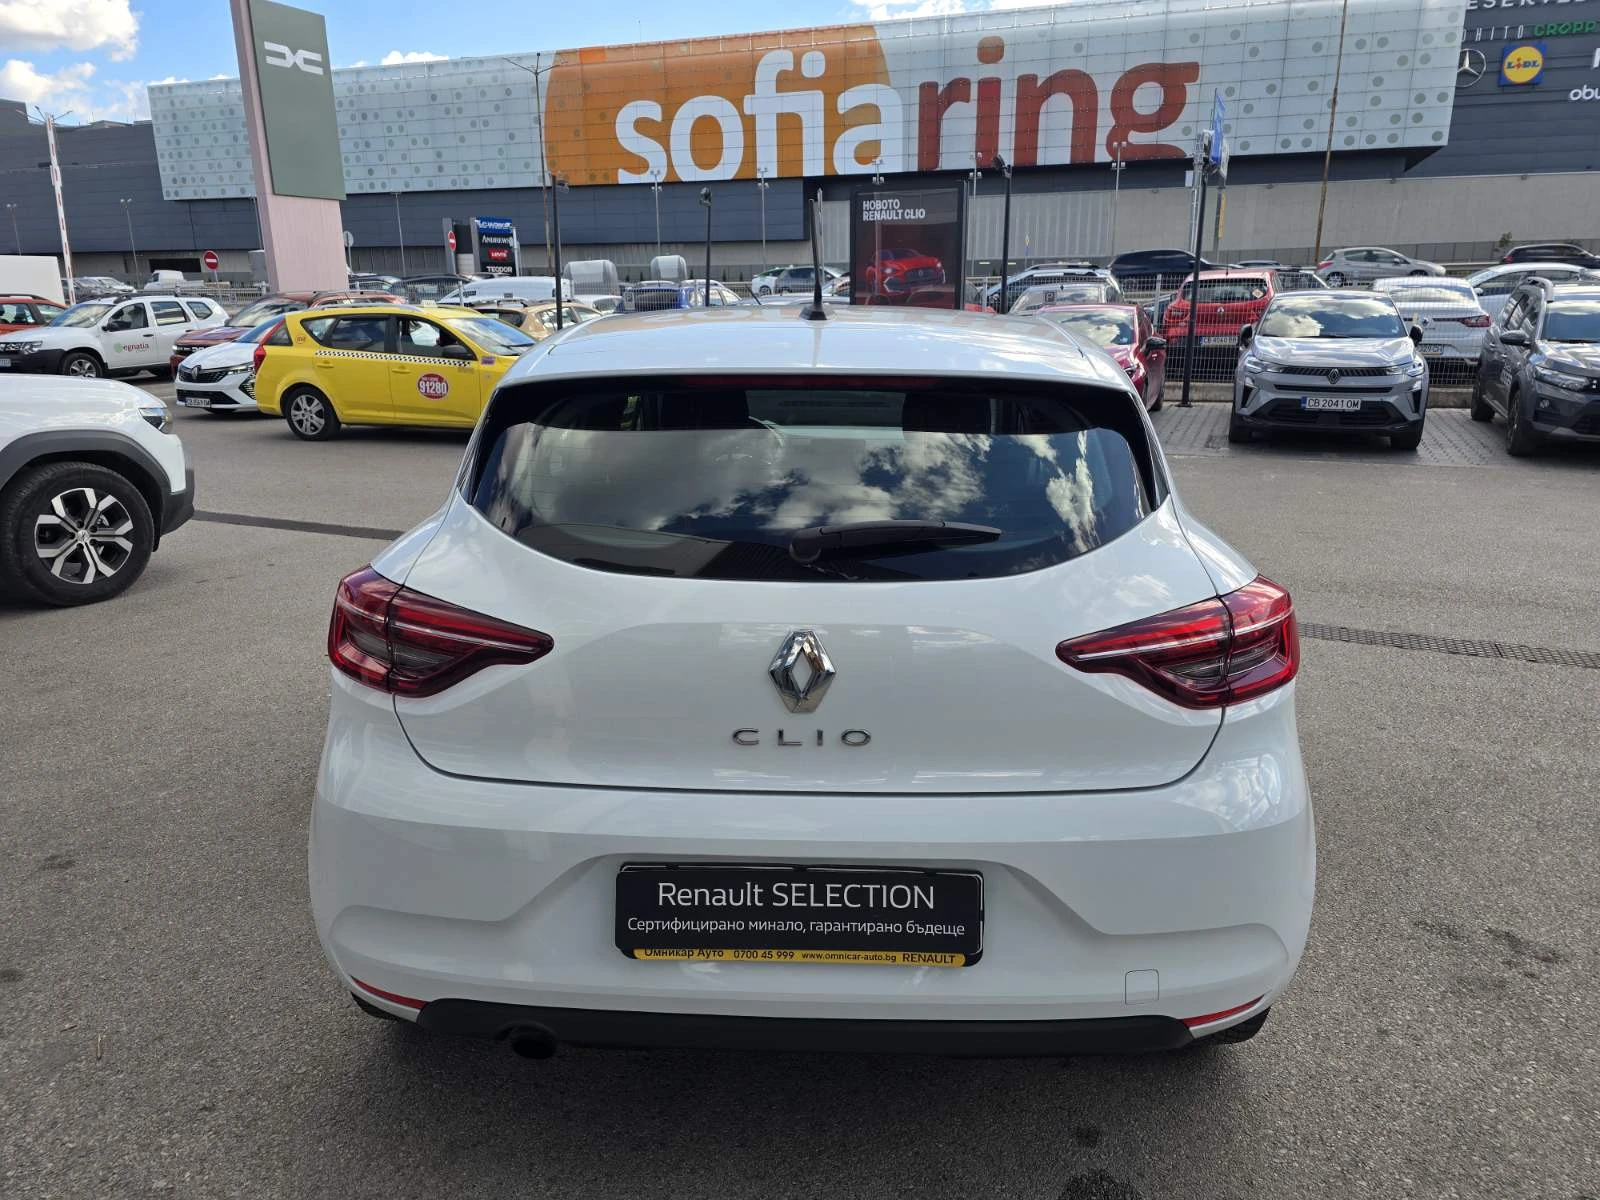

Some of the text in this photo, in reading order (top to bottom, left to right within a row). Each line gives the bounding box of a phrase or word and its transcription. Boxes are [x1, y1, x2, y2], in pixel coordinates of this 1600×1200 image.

[616, 36, 1199, 183] sofia ring
[863, 208, 926, 221] RENAULT CLIO
[419, 380, 448, 395] 91280
[732, 727, 871, 746] CLIO
[658, 881, 934, 909] Renault SELECTION
[628, 917, 965, 937] Сертифицирано минало, гарантирано бъдеще
[733, 950, 758, 959] 0700
[761, 951, 773, 959] 45
[776, 951, 795, 960] 999
[801, 952, 897, 963] www.omnicar-auto.bg
[902, 953, 956, 964] RENAULT
